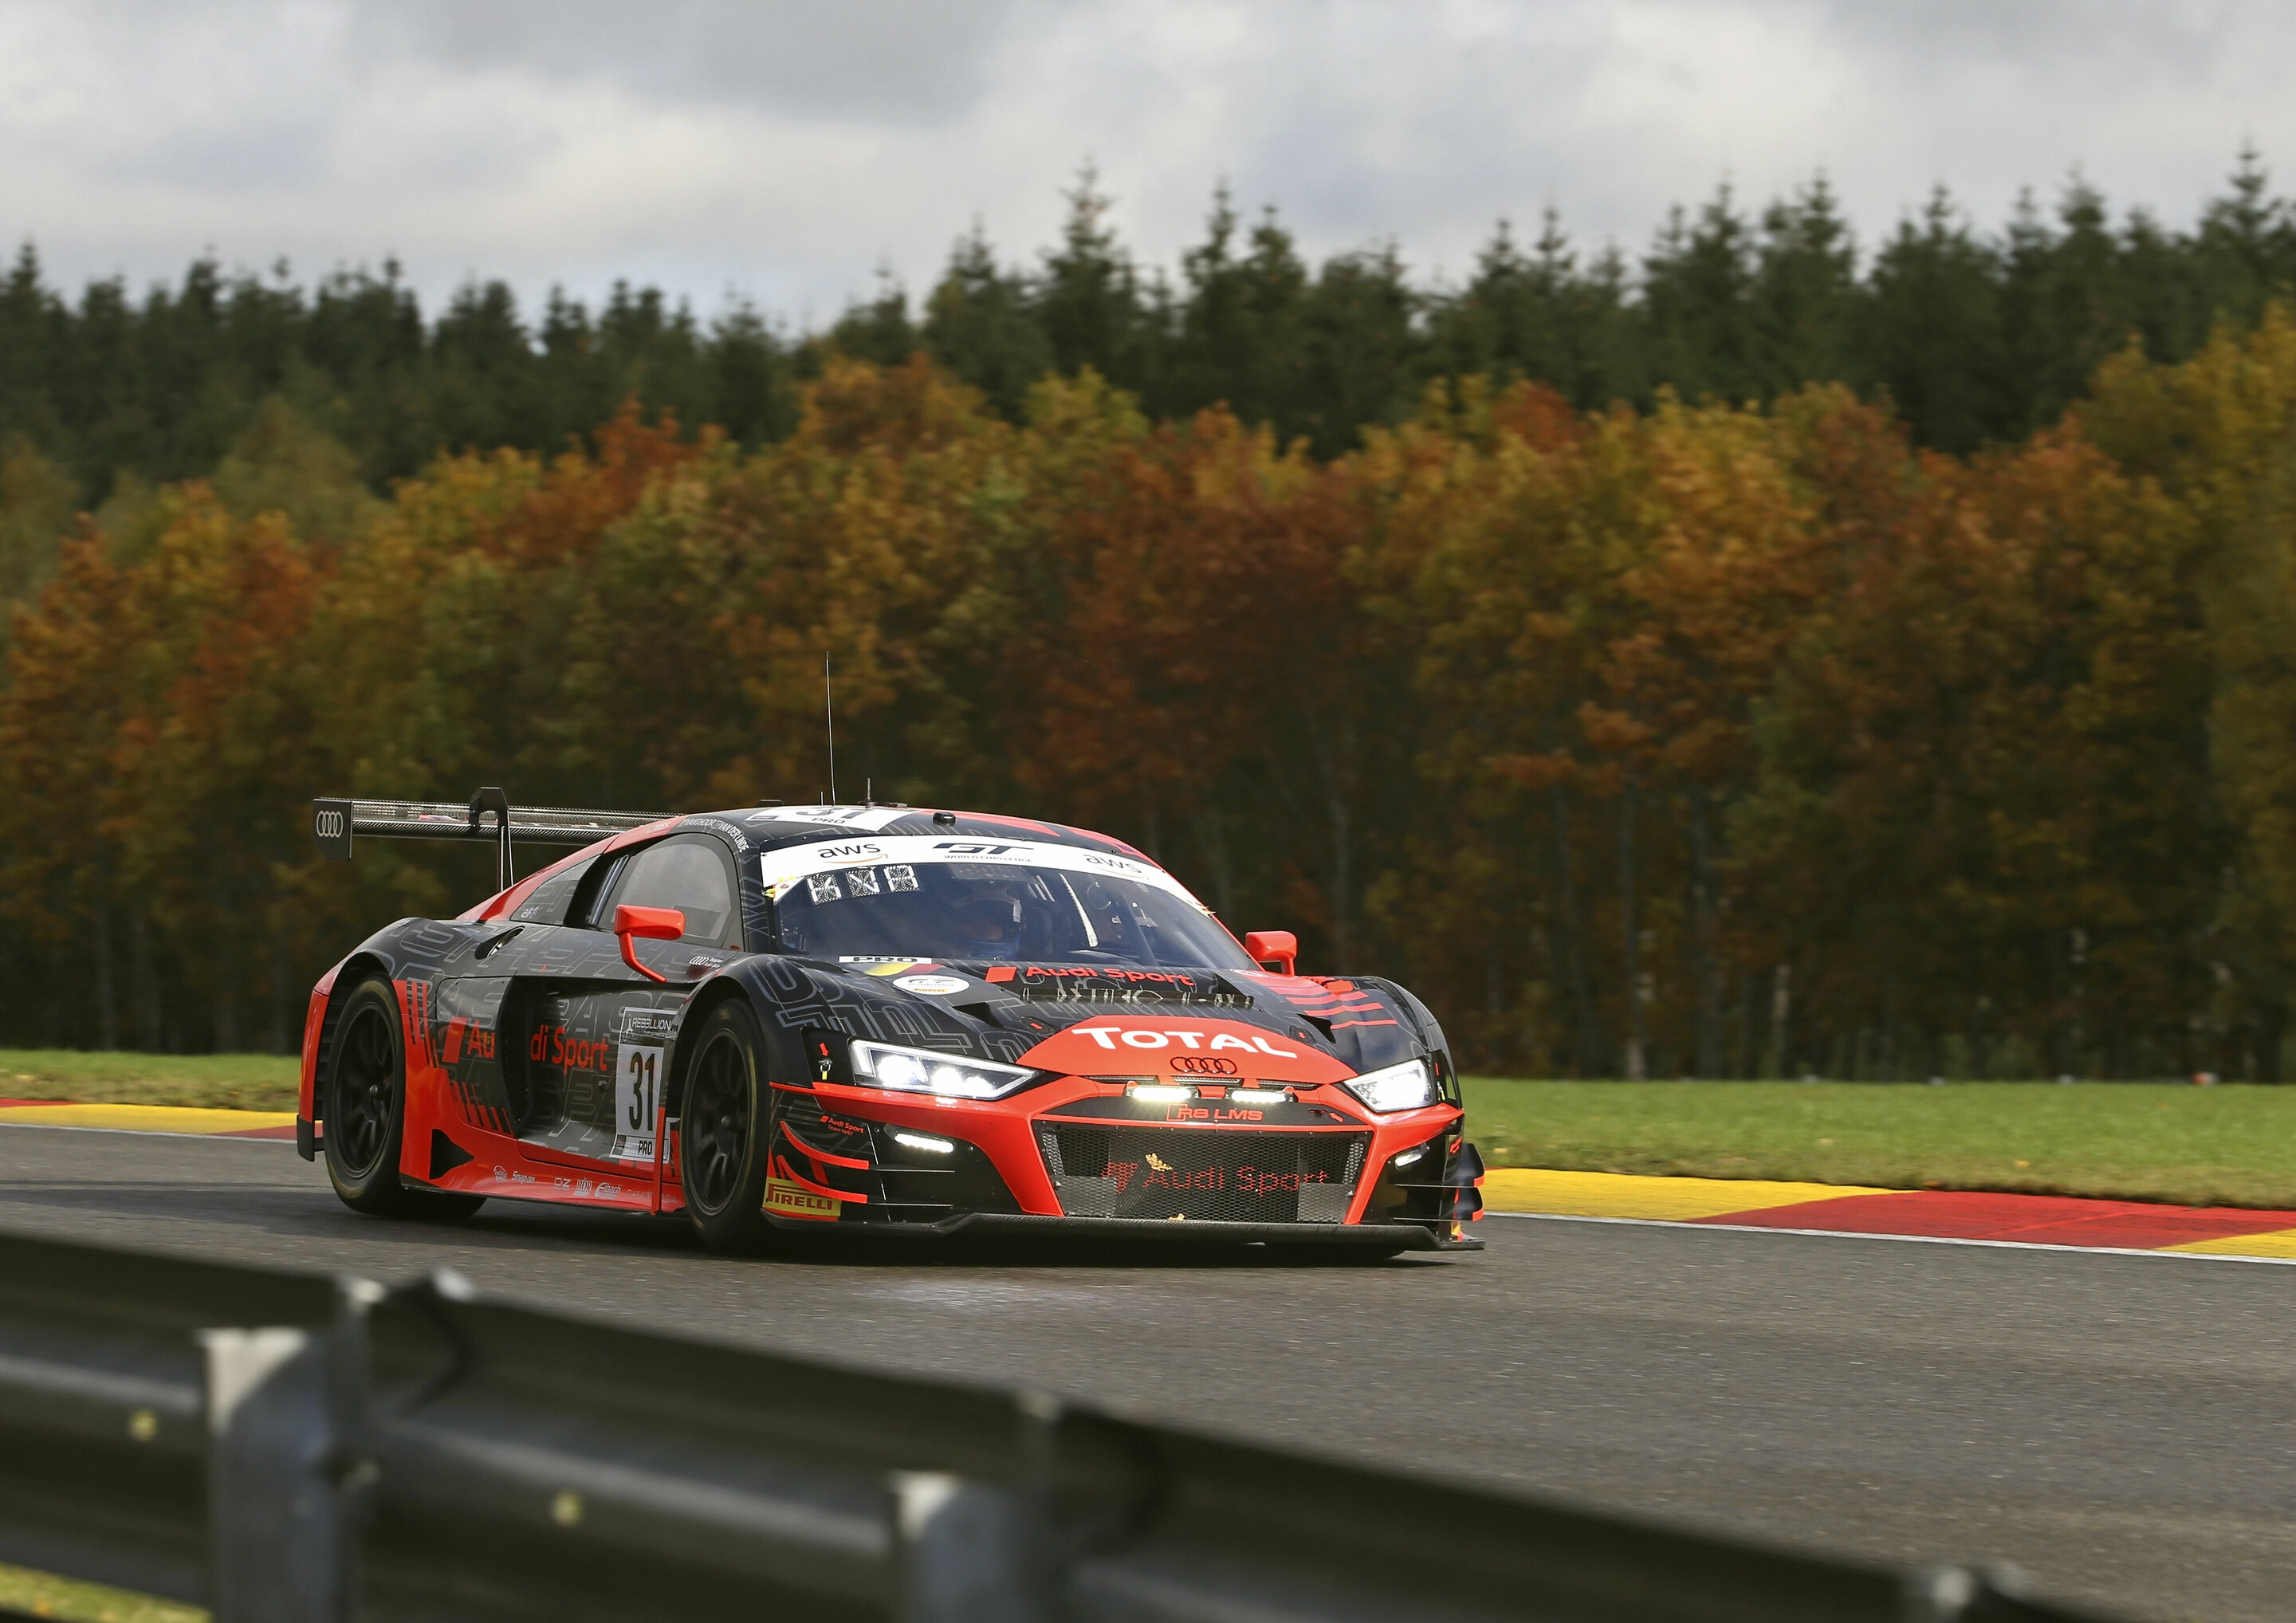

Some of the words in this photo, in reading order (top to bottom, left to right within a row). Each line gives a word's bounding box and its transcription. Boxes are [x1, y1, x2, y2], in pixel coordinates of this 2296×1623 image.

[817, 843, 881, 859] aws
[1083, 855, 1142, 874] aws
[1026, 966, 1098, 977] Audi
[1106, 968, 1196, 987] Sport
[632, 1017, 671, 1031] REBELLION
[552, 1026, 610, 1075] Sport
[1071, 1027, 1297, 1059] TOTAL
[628, 1051, 656, 1131] 31
[1176, 1107, 1209, 1119] R8
[1213, 1108, 1263, 1121] LMS
[828, 1118, 845, 1128] Audi
[845, 1122, 865, 1134] Sport
[638, 1140, 653, 1156] PRO
[512, 1170, 536, 1184] Snap-on
[554, 1177, 571, 1188] OZ
[1142, 1166, 1225, 1189] Audi
[1236, 1165, 1331, 1197] Sport
[768, 1183, 834, 1210] PIRELLI
